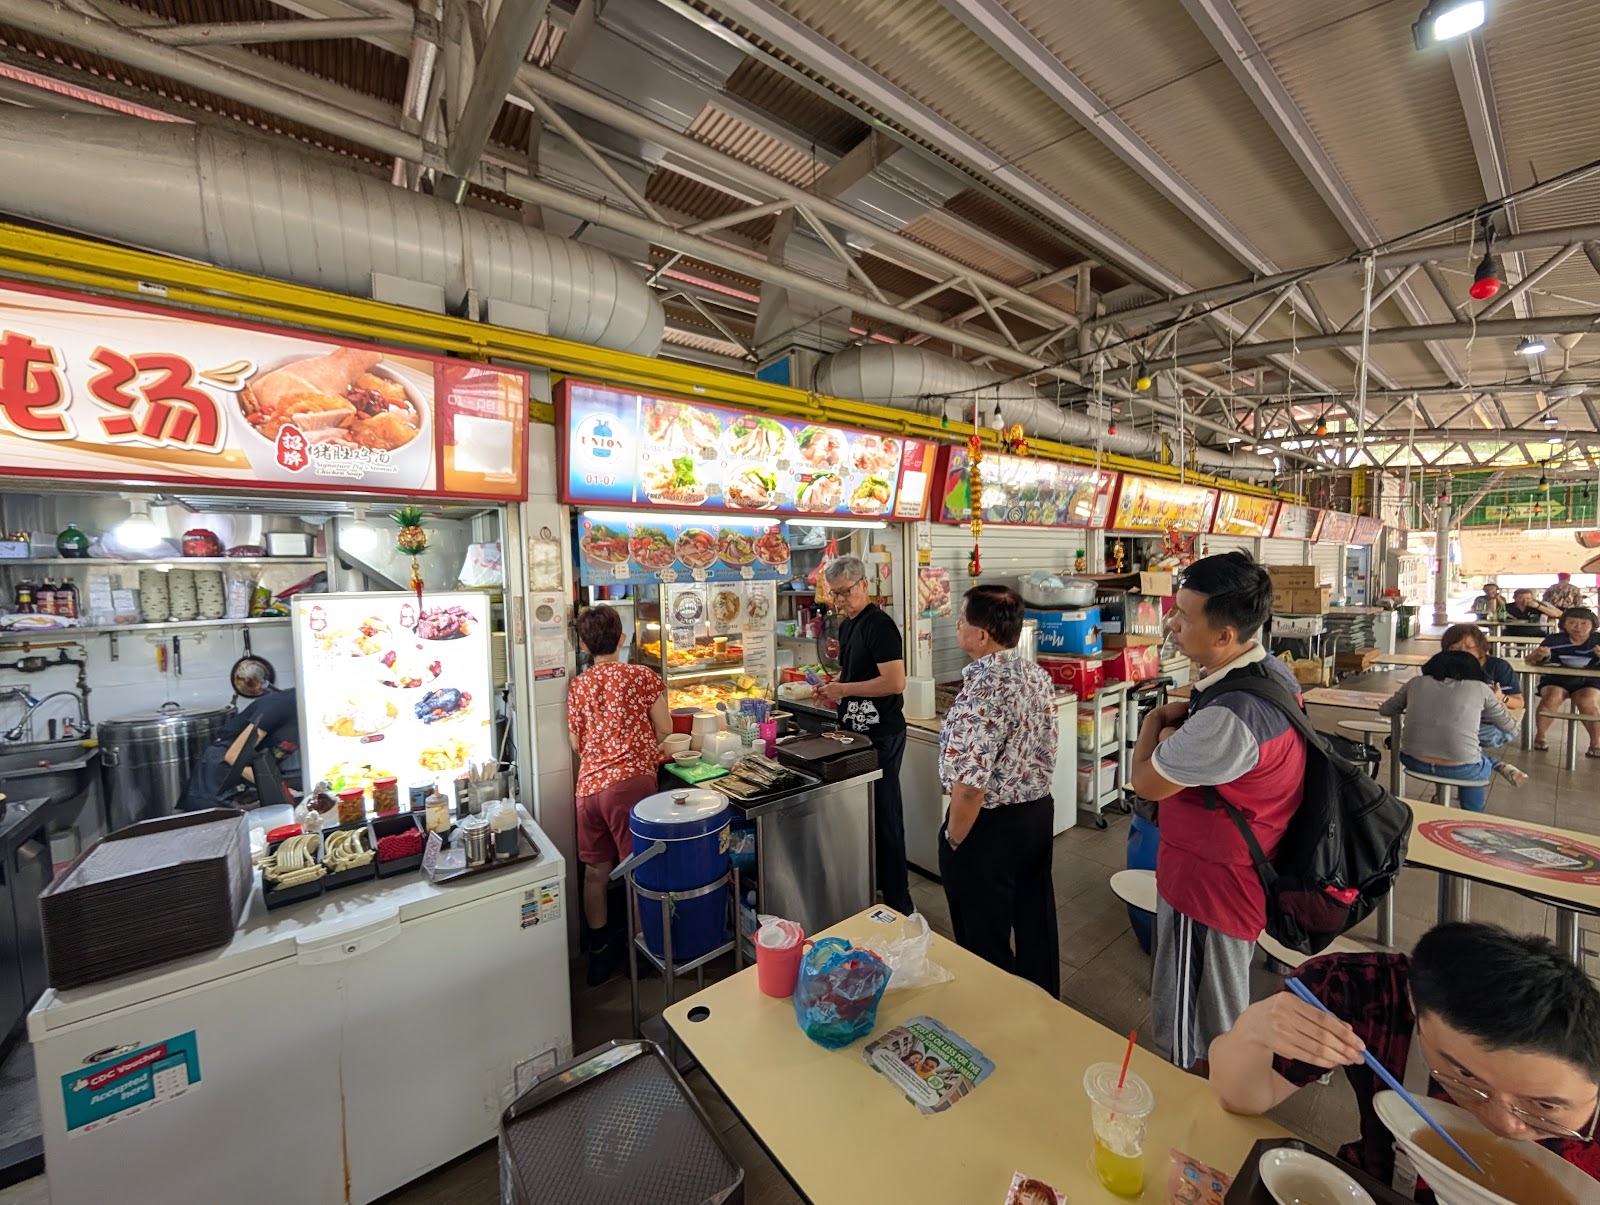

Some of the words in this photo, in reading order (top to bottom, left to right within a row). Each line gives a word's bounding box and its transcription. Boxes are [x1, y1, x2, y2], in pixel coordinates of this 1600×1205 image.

[282, 432, 304, 467] 招牌
[581, 436, 623, 448] UNION
[313, 444, 391, 464] 猪肚鸡汤
[316, 468, 345, 476] Chicken
[346, 469, 363, 479] Soup
[586, 474, 616, 486] 01-07
[1100, 595, 1120, 604] APPLE
[1131, 624, 1144, 634] FUJI
[1145, 624, 1160, 634] APPLE
[908, 1026, 926, 1041] HEALTH
[923, 1039, 950, 1061] SCREENING
[949, 1058, 961, 1069] YOU
[959, 1067, 976, 1081] NEED!
[913, 1025, 930, 1035] JUST
[934, 1038, 944, 1047] OR
[942, 1044, 957, 1057] LESS
[955, 1053, 969, 1066] FOR
[967, 1062, 981, 1075] THE
[90, 1069, 116, 1086] CDC
[116, 1050, 161, 1073] Voucher
[90, 1073, 148, 1105] Accepted
[121, 1083, 149, 1100] here
